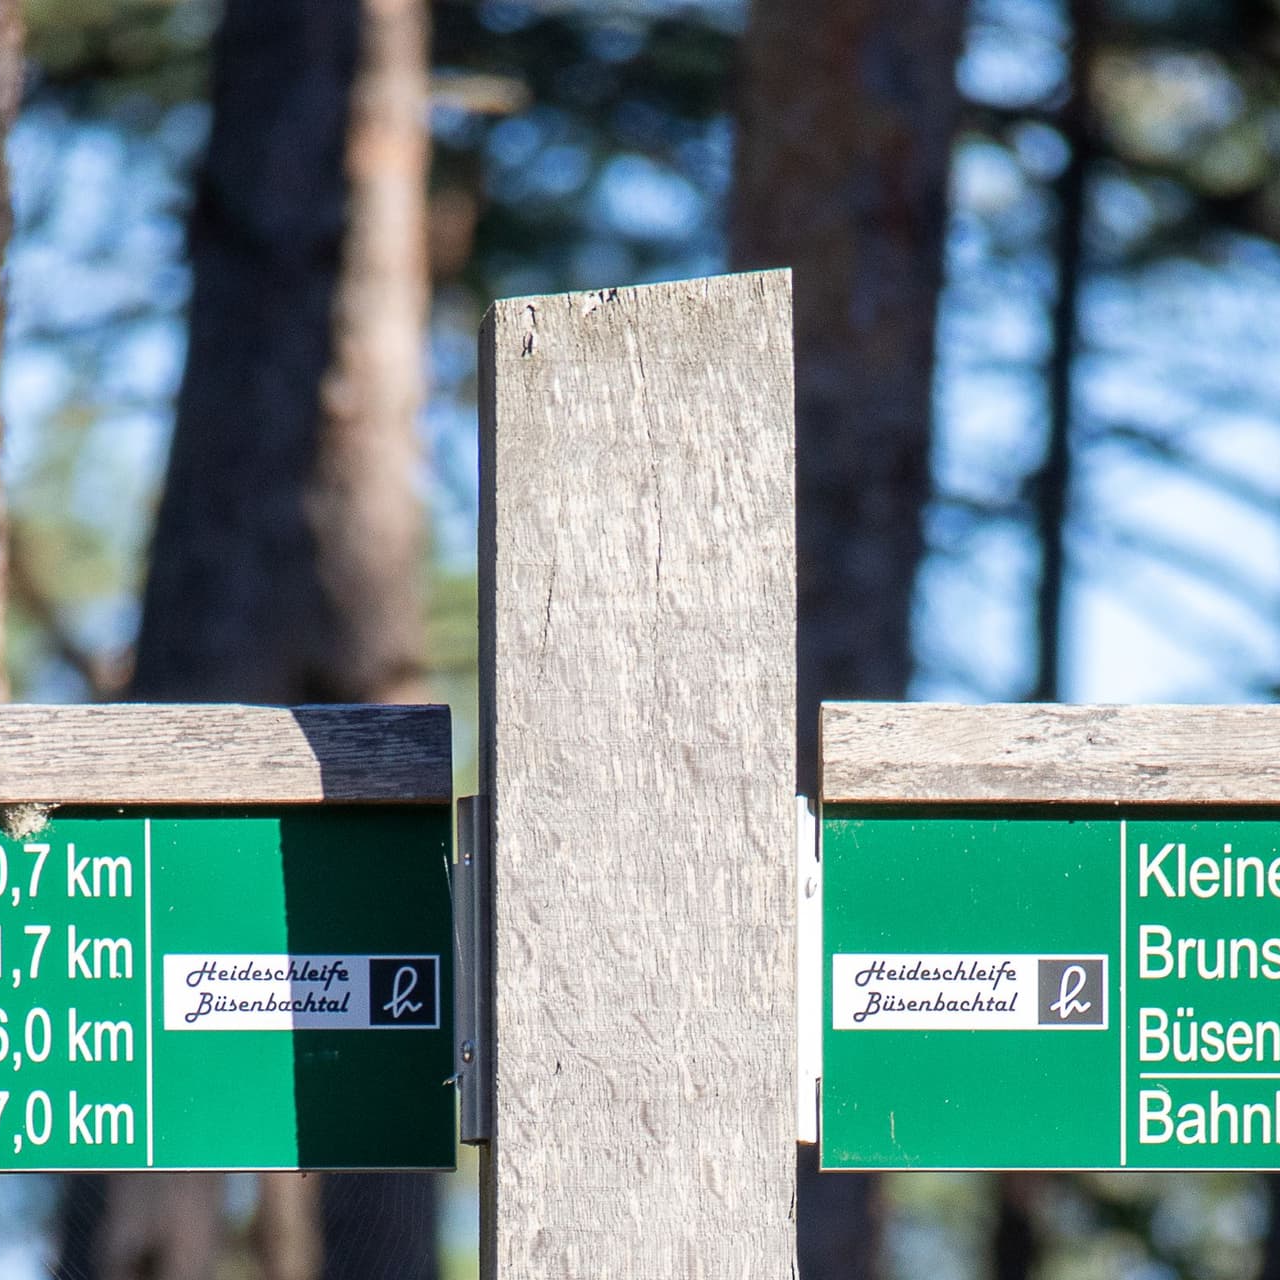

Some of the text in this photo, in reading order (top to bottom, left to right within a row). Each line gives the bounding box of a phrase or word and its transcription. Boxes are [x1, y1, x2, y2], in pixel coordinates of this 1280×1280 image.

[68, 843, 132, 898] km
[68, 925, 132, 979] km
[185, 961, 349, 990] Heideschleife
[855, 961, 1017, 990] Heideschleife
[185, 992, 350, 1023] Büsenbachtal
[853, 992, 1018, 1023] Büsenbachtal
[69, 1008, 133, 1062] km
[70, 1091, 134, 1144] km
